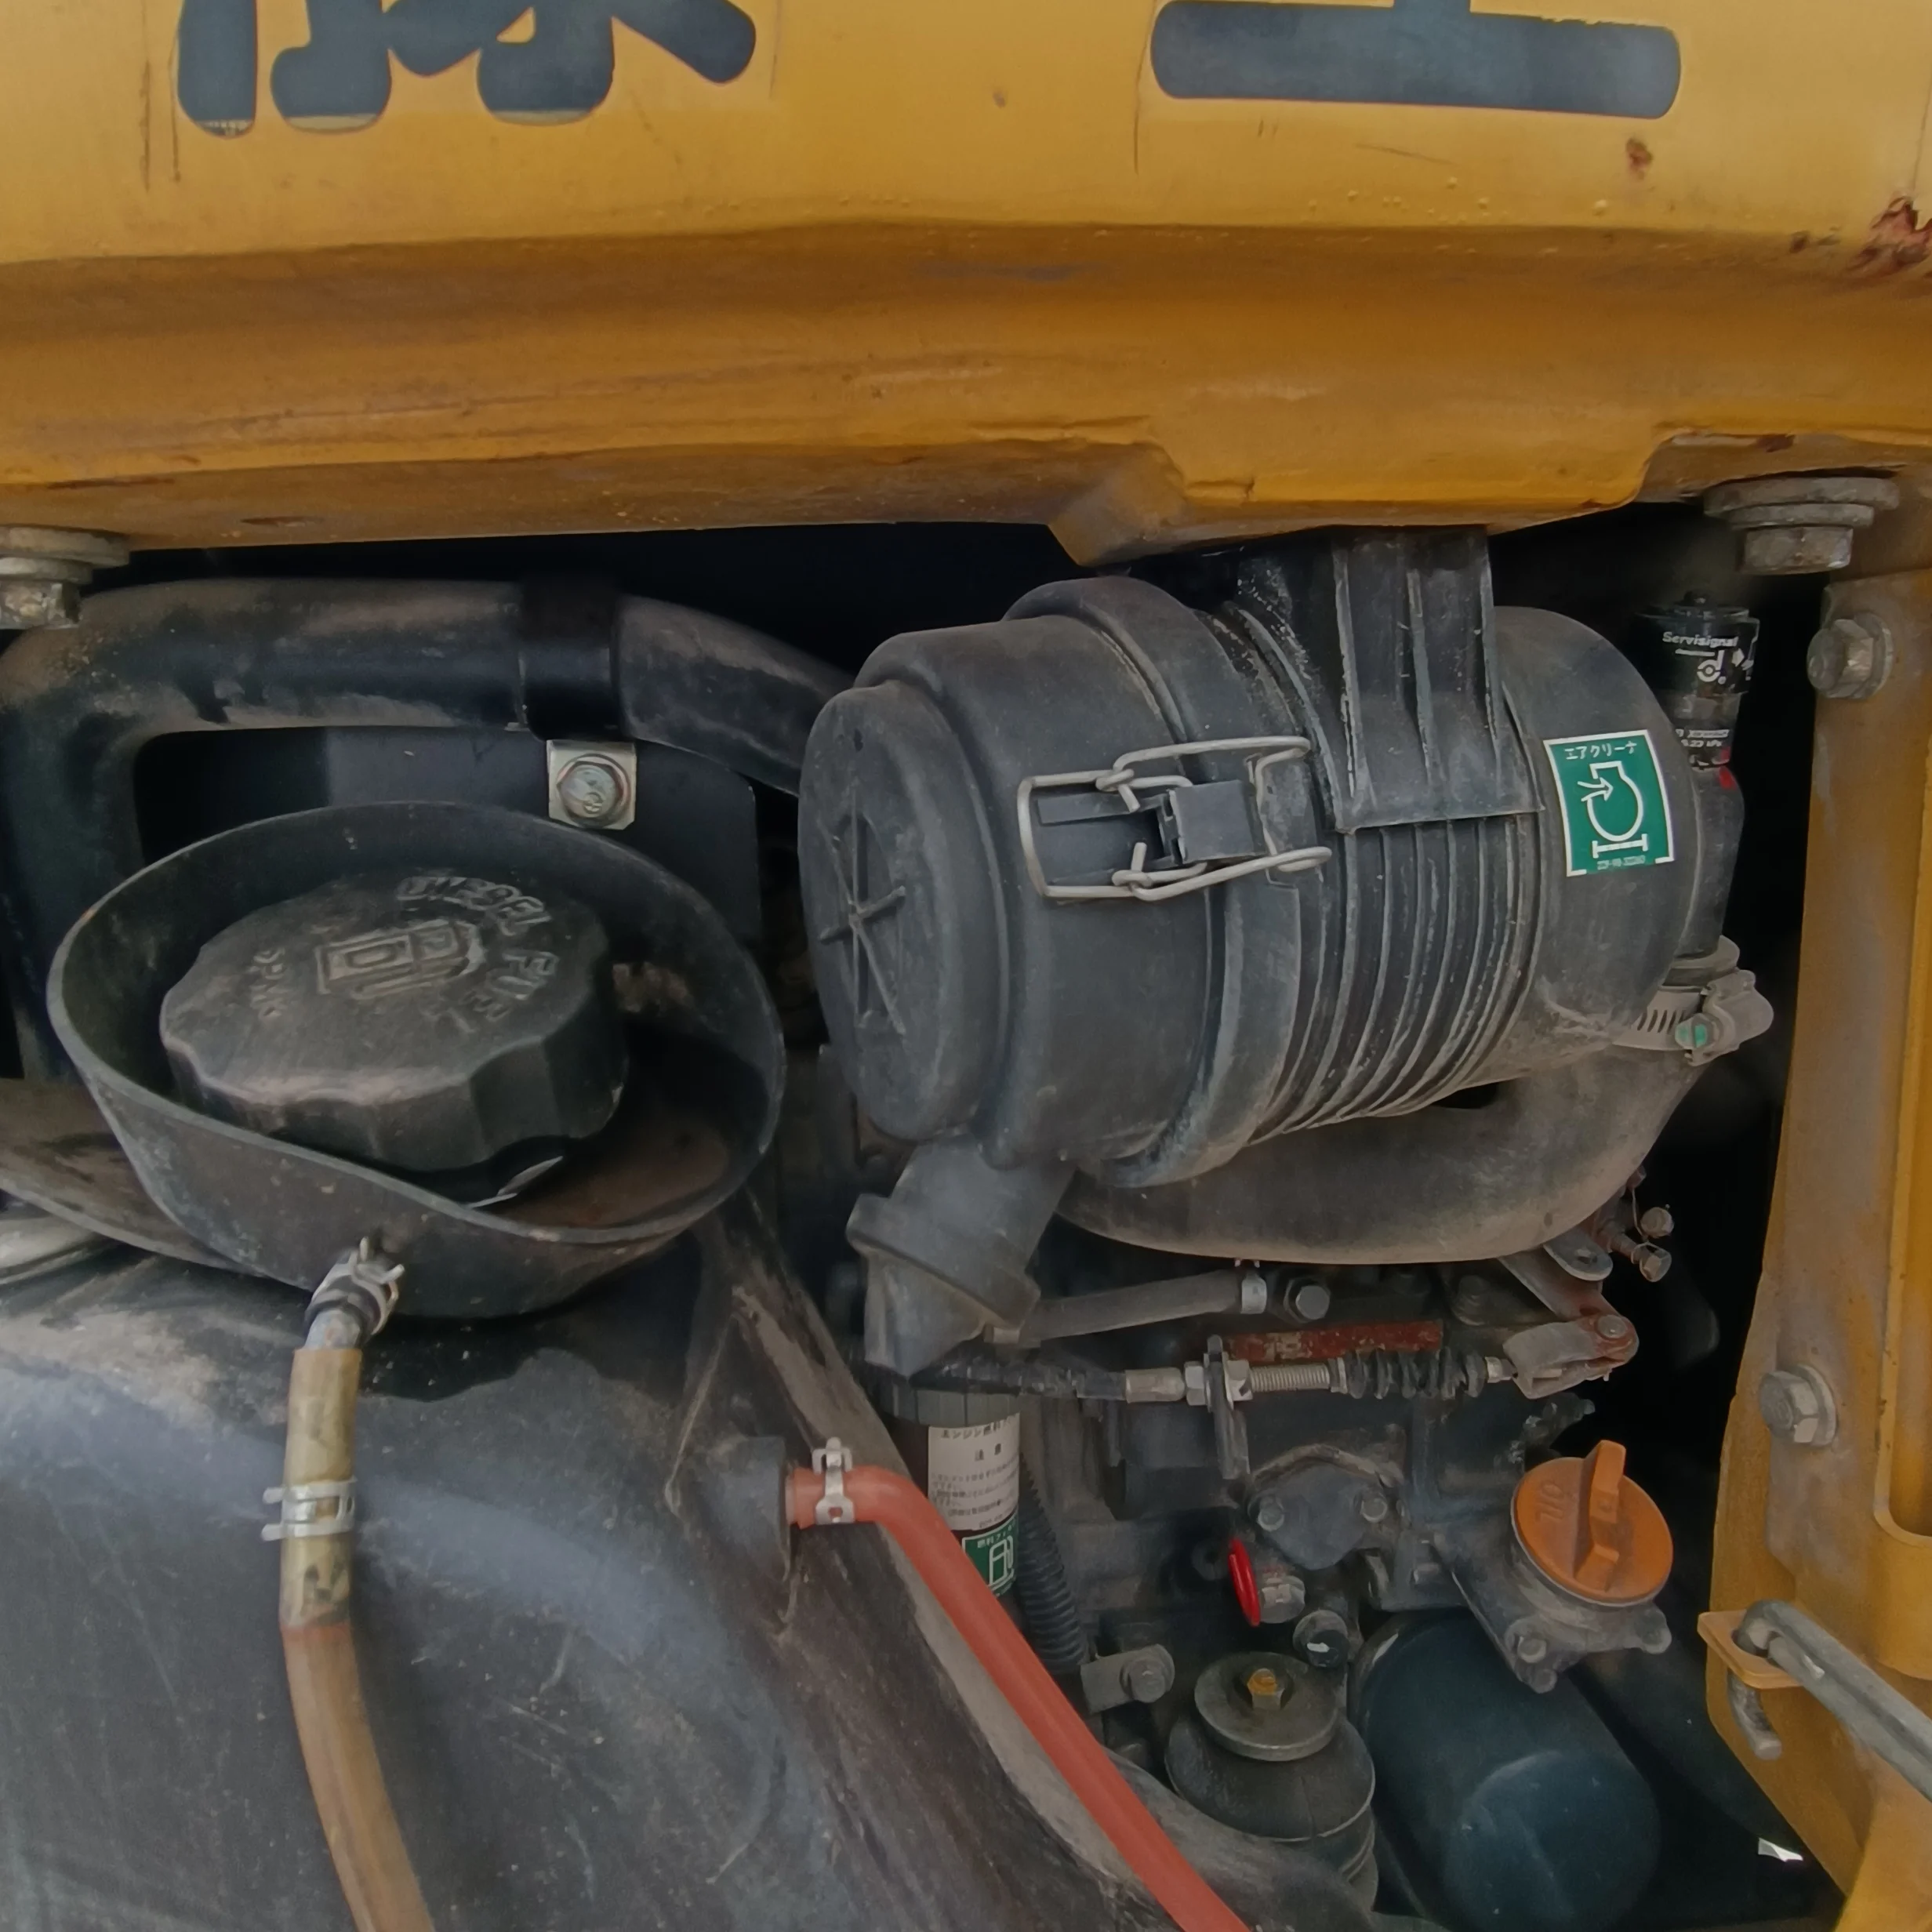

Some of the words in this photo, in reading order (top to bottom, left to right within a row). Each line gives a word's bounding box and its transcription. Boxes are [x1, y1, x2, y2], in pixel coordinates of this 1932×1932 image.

[1564, 740, 1637, 760] エアクリーナ
[1534, 1480, 1566, 1523] OIL
